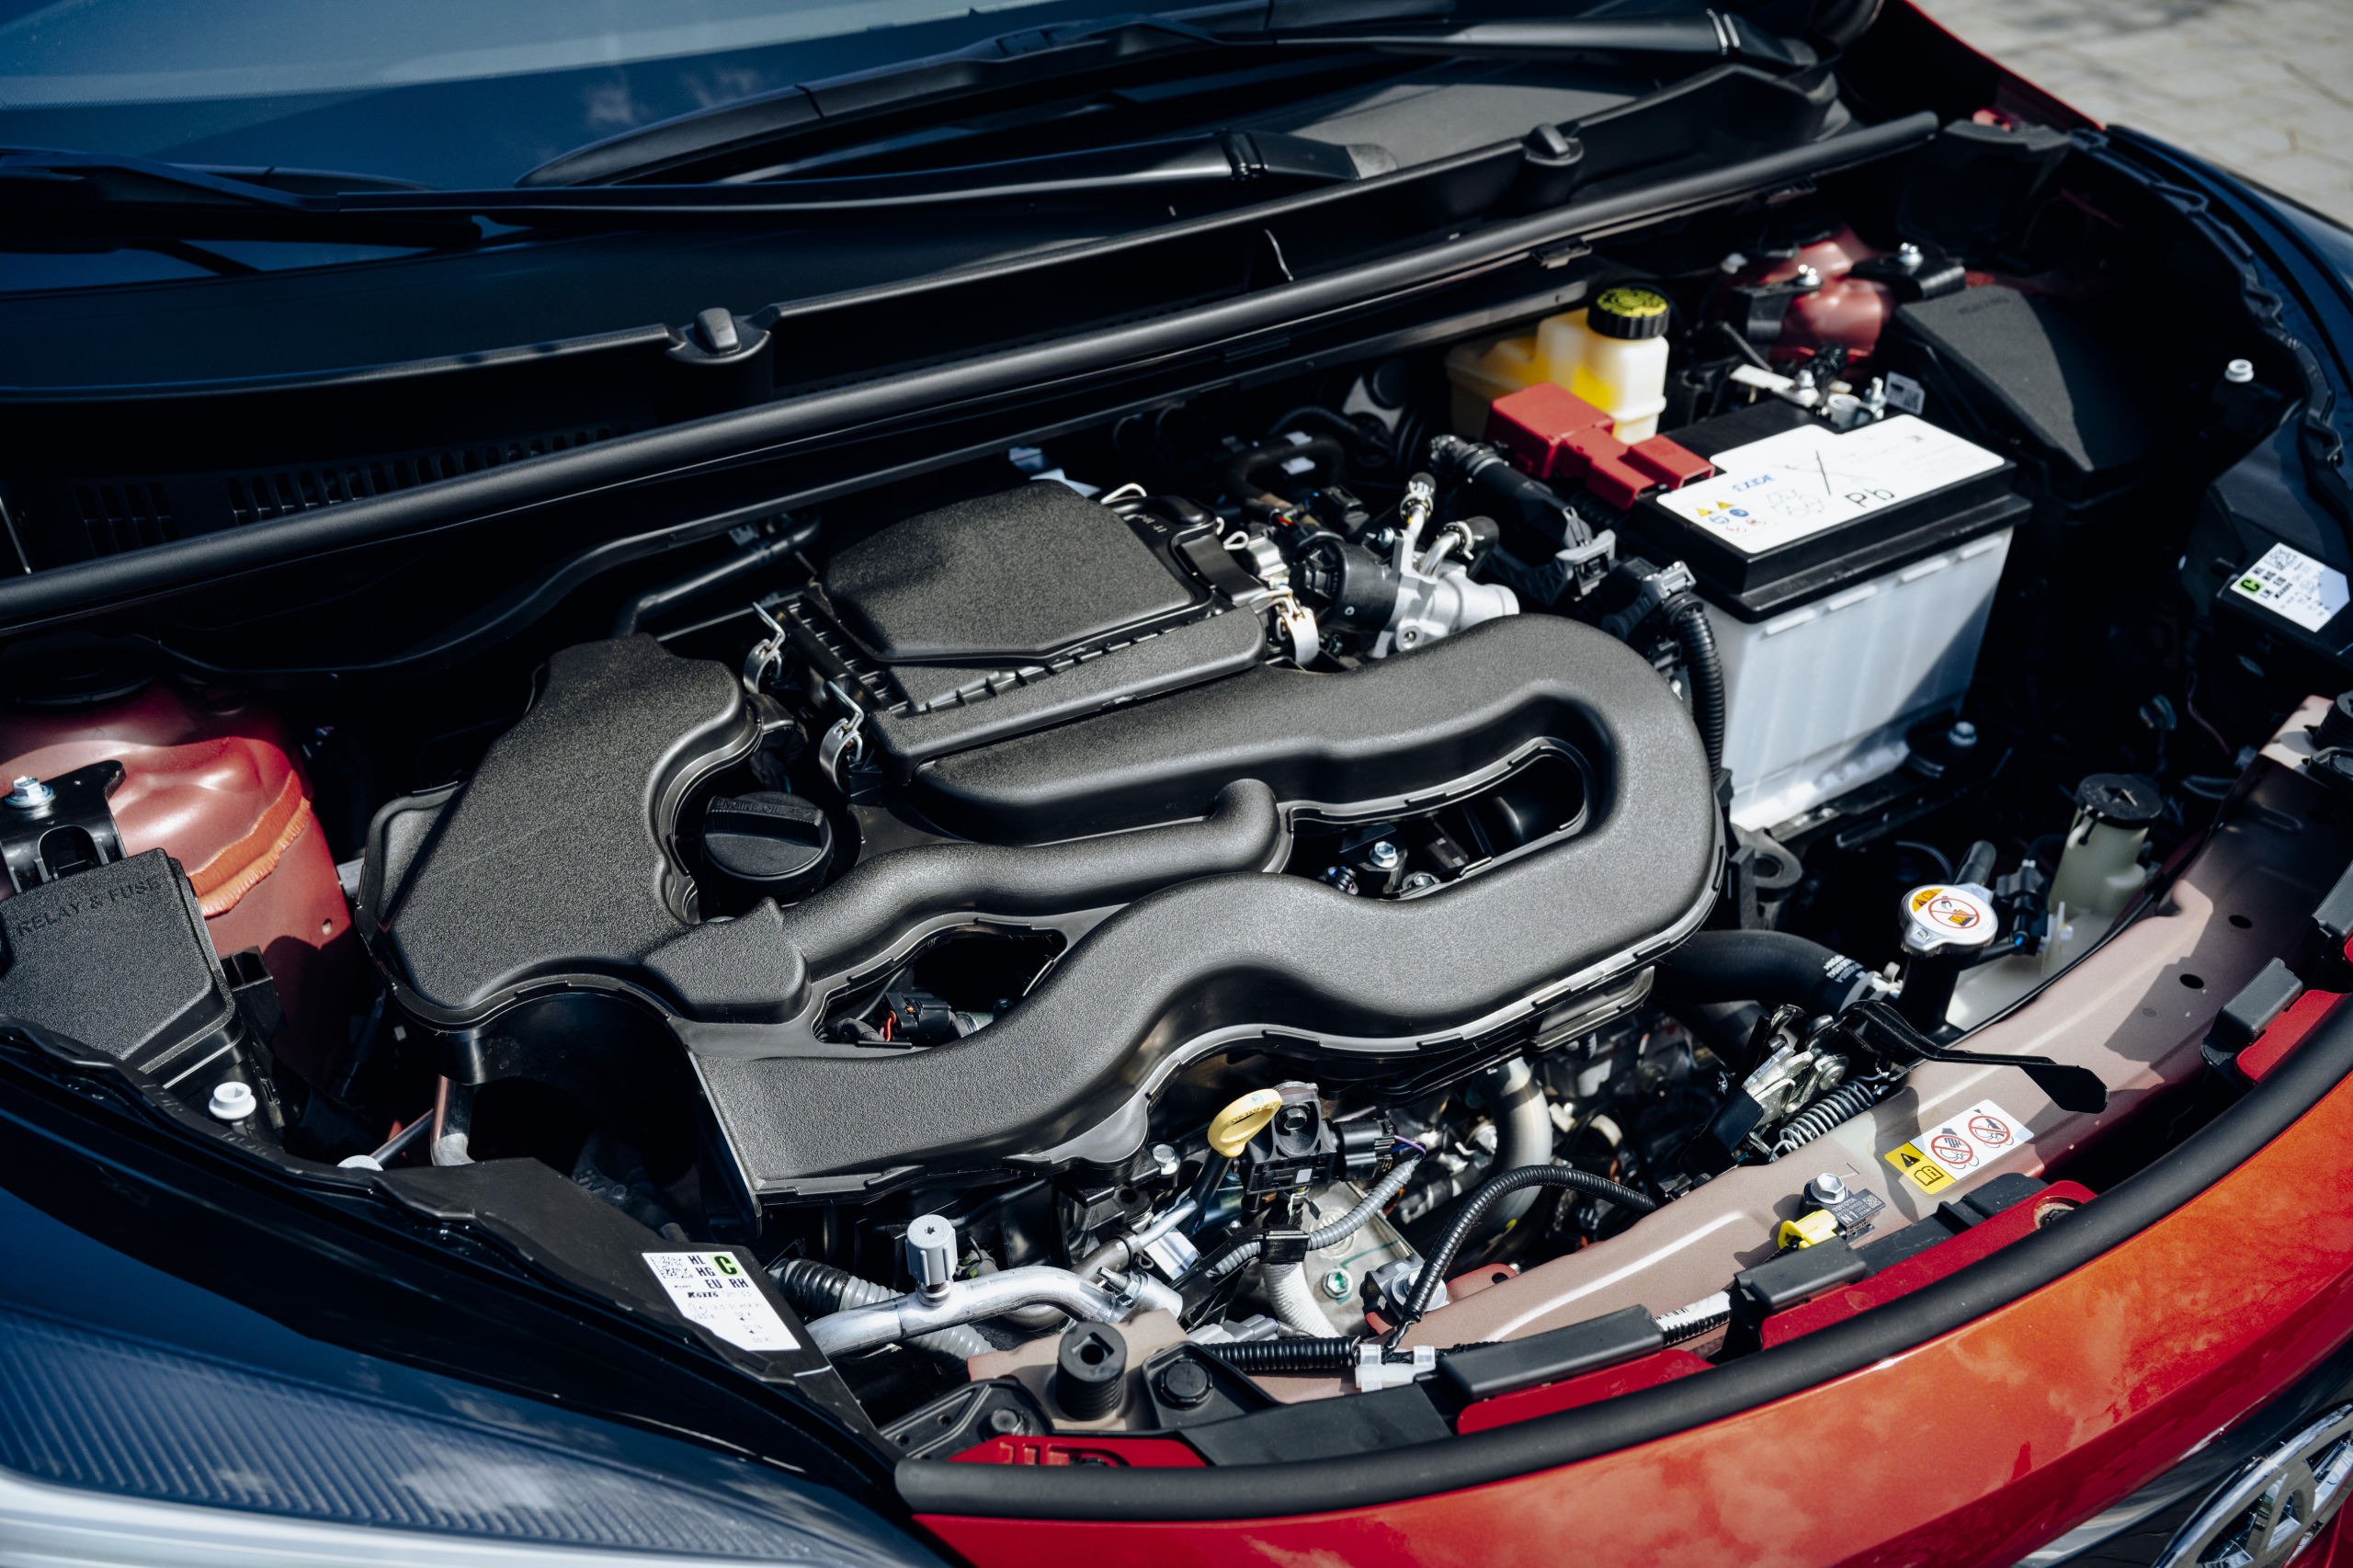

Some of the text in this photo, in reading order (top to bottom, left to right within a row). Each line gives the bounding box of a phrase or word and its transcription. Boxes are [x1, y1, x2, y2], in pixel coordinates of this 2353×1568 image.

[1844, 488, 1895, 508] Pb
[2240, 579, 2260, 592] C
[17, 876, 162, 937] RELAY & FUSE
[1832, 1198, 1858, 1212] TOYOTA
[688, 1256, 706, 1265] HL
[714, 1256, 738, 1276] C
[696, 1267, 716, 1277] HG
[705, 1278, 749, 1289] EU RH
